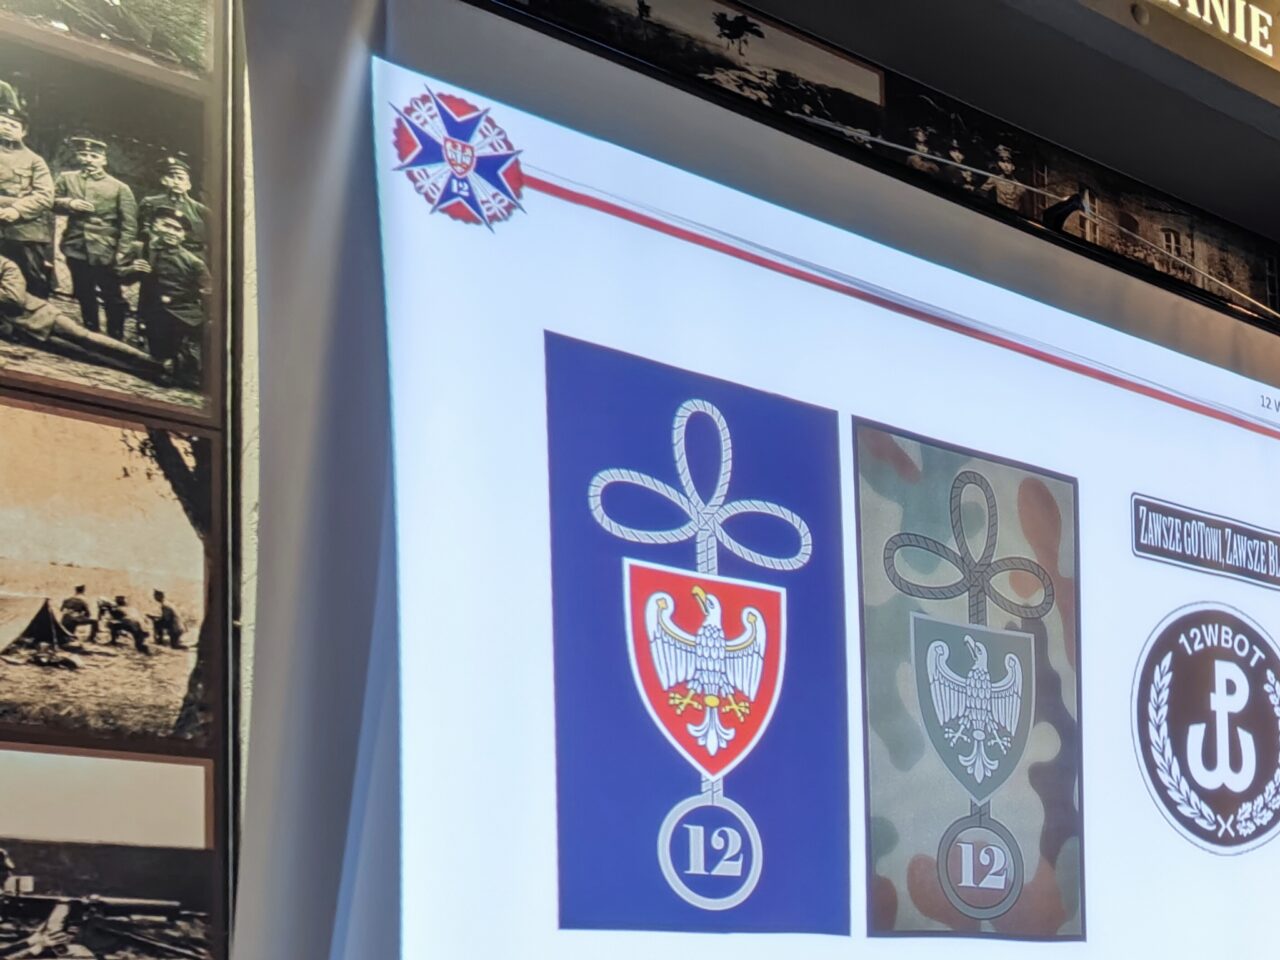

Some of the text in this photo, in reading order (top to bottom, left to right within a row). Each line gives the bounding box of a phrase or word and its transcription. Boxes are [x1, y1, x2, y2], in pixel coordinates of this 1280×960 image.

[1260, 394, 1273, 410] 12
[1139, 505, 1183, 554] ZAWSZE
[1225, 528, 1267, 575] ZAWSZE
[1178, 623, 1266, 668] 12WBOT
[682, 823, 744, 877] 12
[956, 842, 1007, 890] 12
